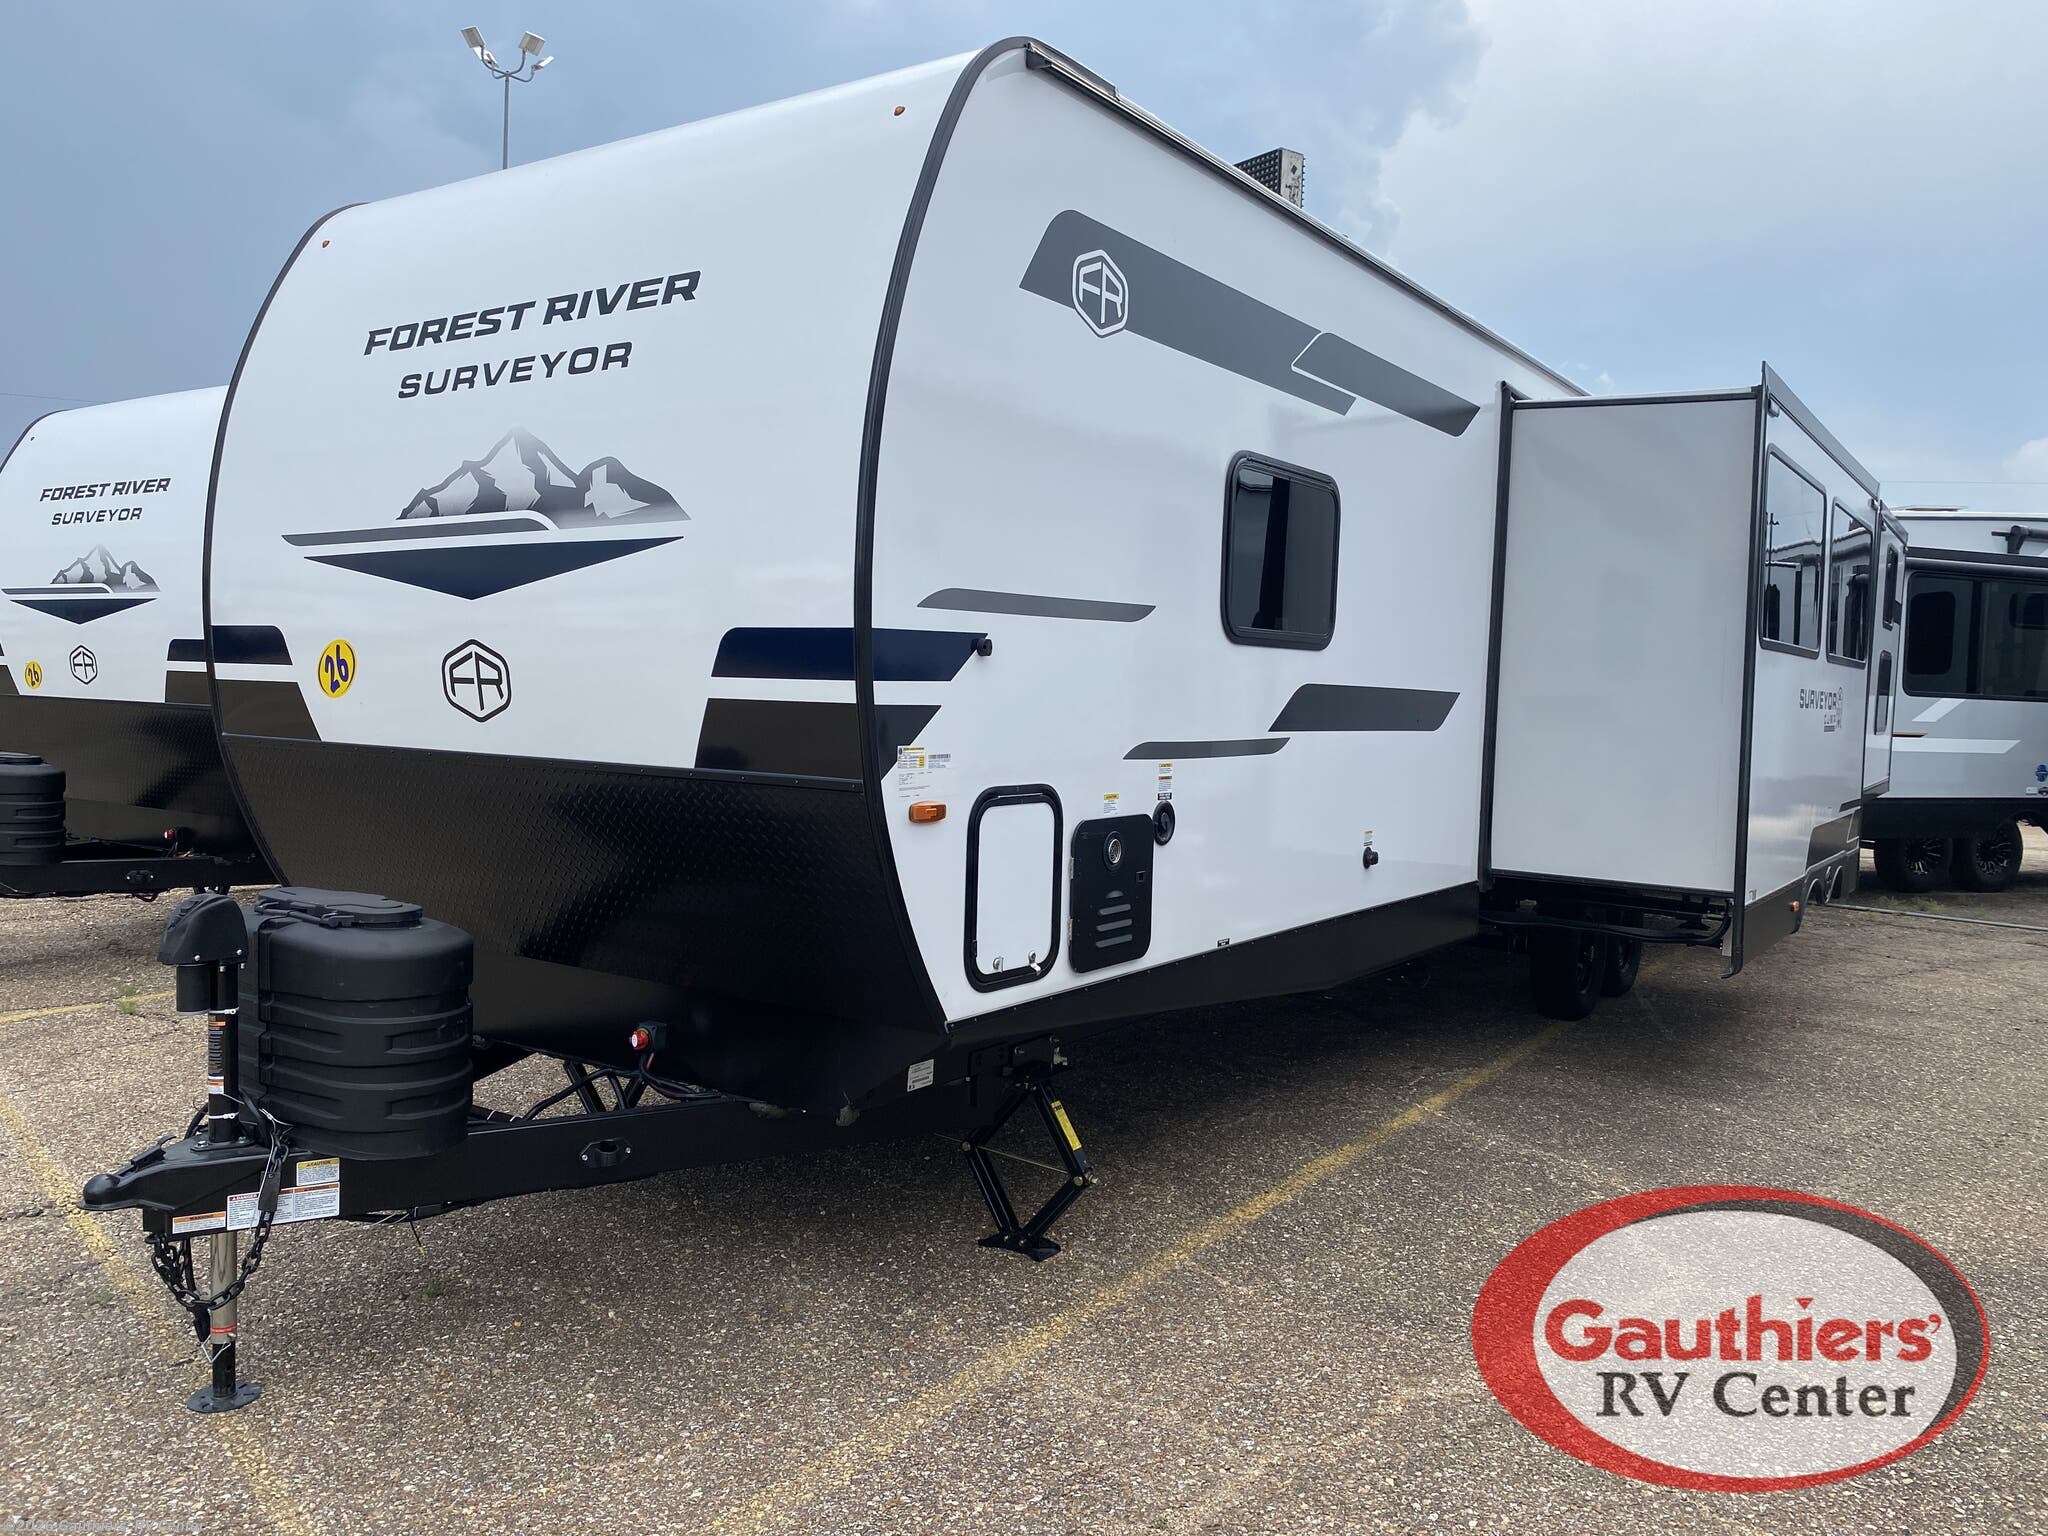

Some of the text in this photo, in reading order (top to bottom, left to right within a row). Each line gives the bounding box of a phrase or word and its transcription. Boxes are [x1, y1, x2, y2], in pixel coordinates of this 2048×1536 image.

[364, 270, 701, 355] FOREST RIVER
[399, 342, 633, 398] SURVEYOR
[40, 477, 171, 501] FOREST RIVER
[51, 507, 143, 525] SURVEYOR
[28, 663, 40, 686] 26
[324, 644, 350, 692] 26
[1800, 688, 1837, 710] SURVEYOR
